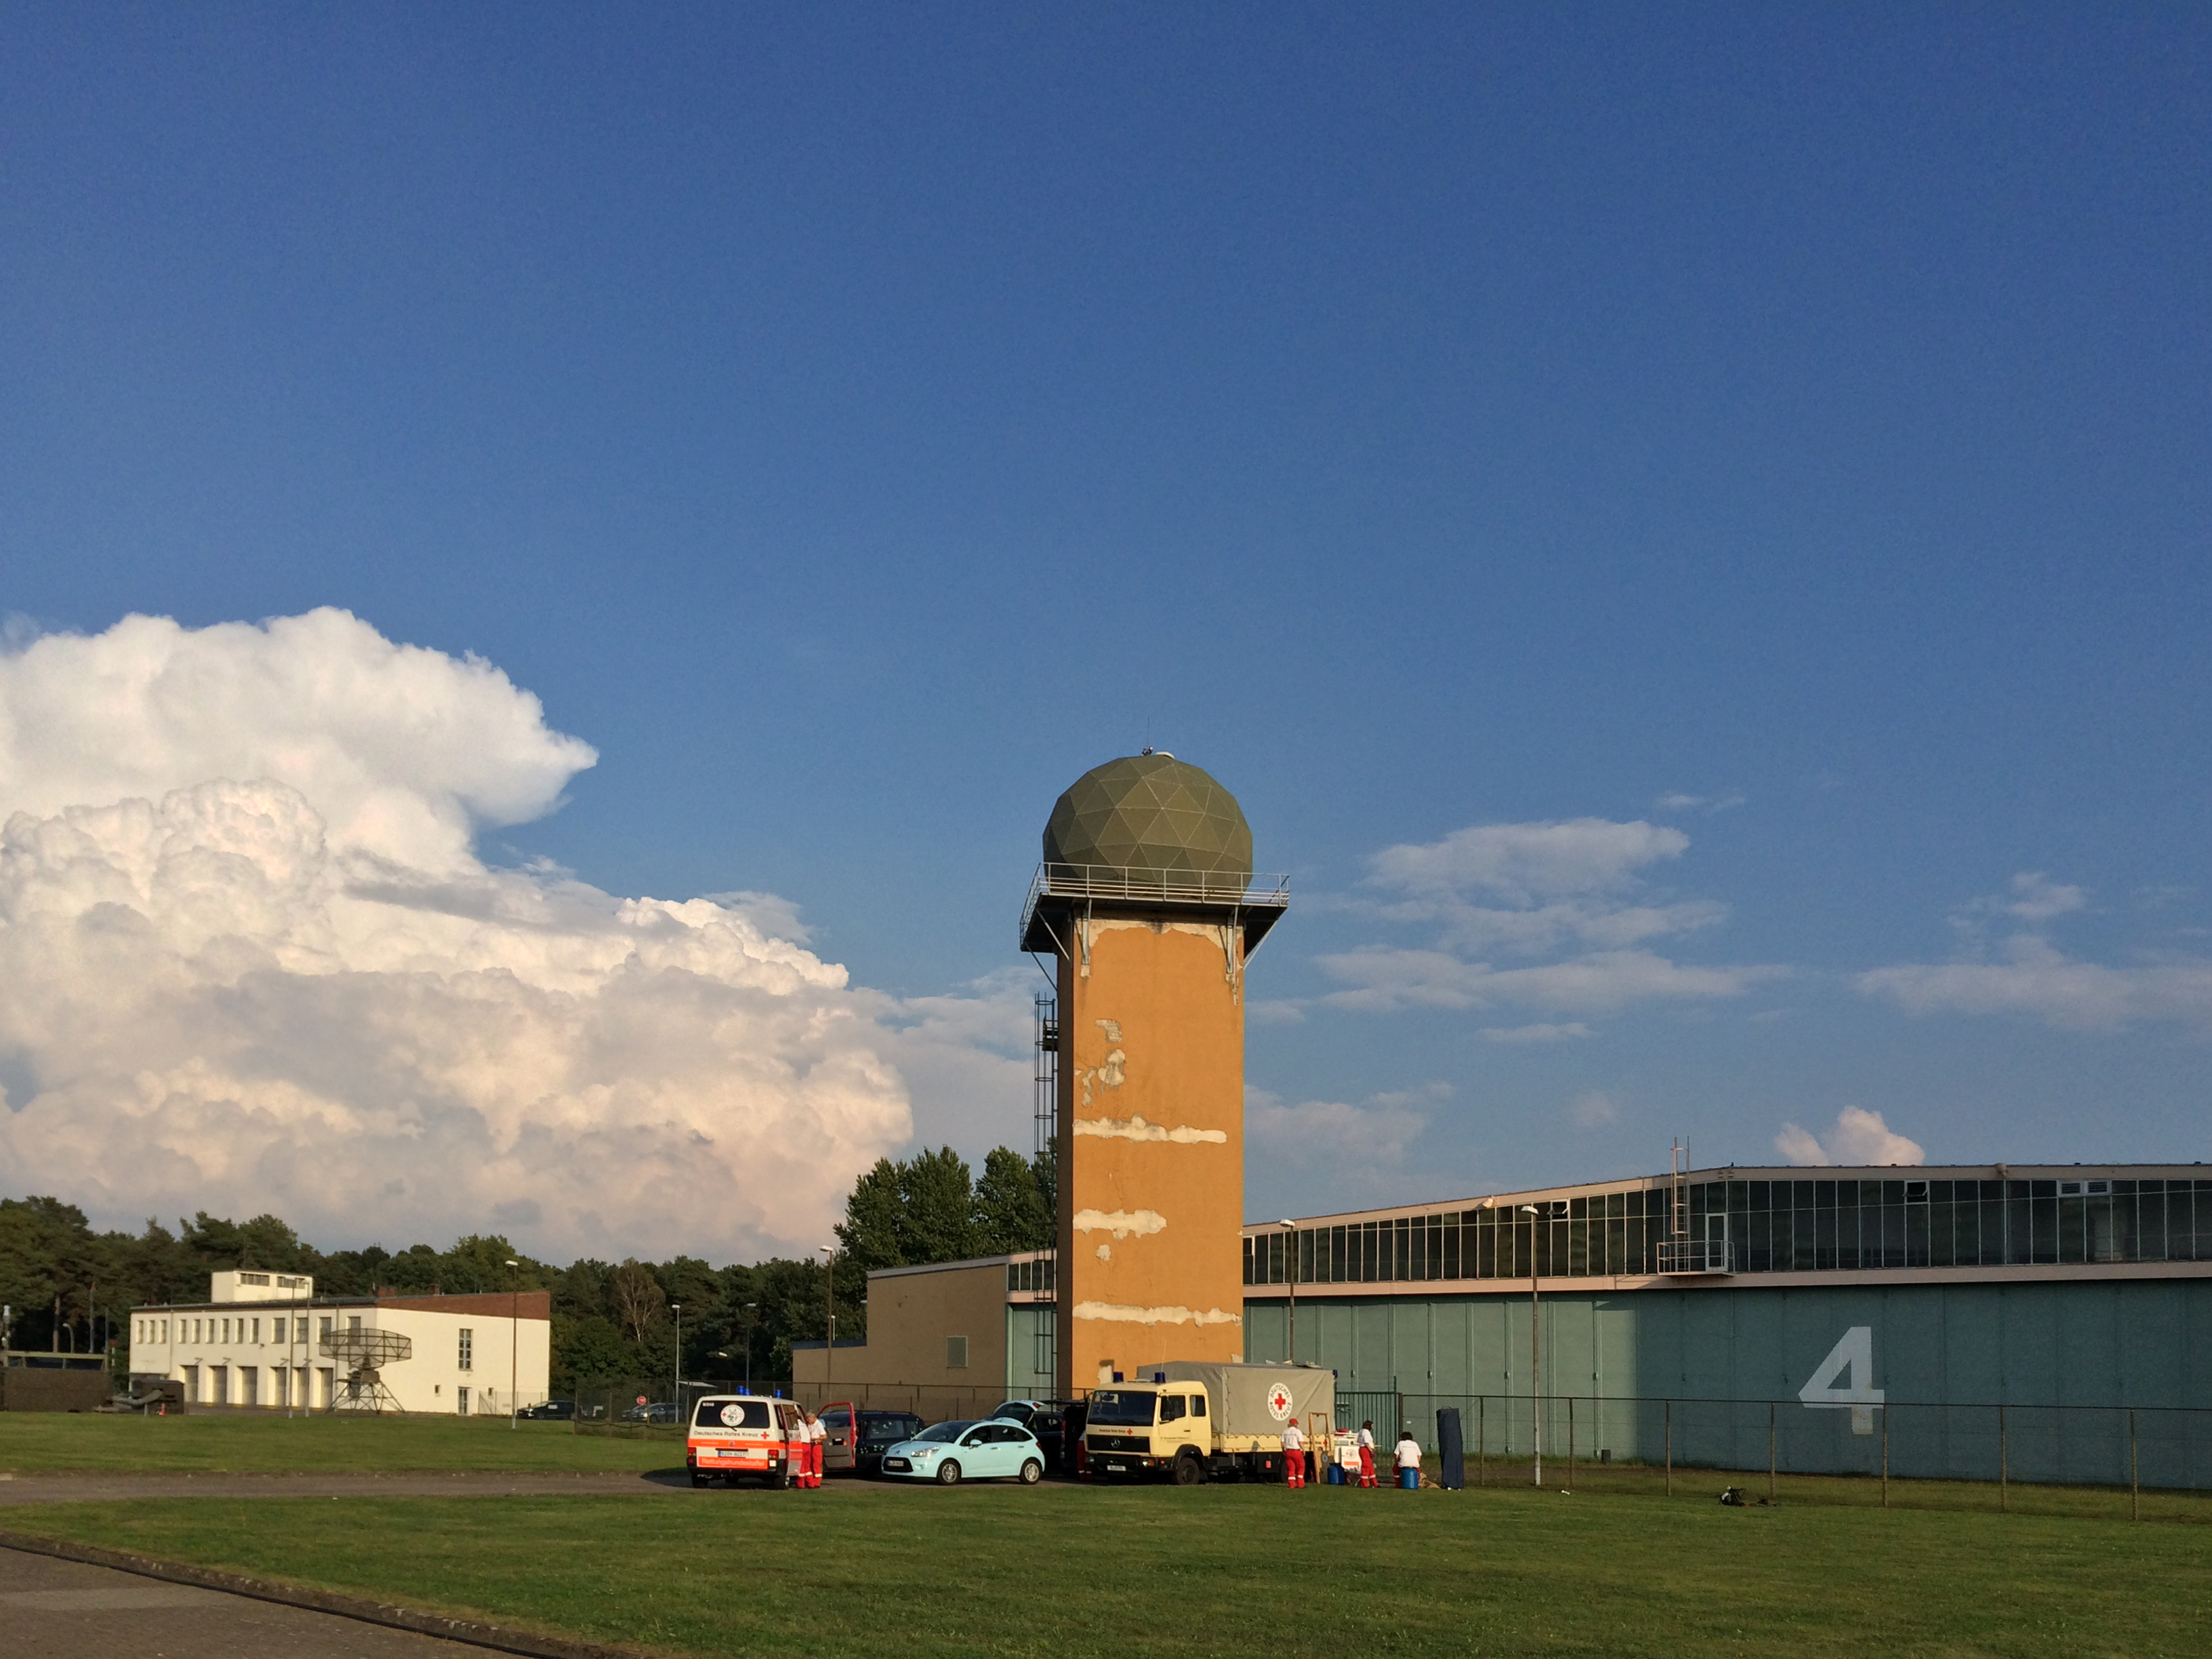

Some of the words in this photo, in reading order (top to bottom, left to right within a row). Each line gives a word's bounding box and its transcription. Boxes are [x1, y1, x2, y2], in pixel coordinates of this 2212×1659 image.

[1798, 1326, 1885, 1435] 4
[1269, 1385, 1290, 1397] DEUTSCHES
[1269, 1401, 1279, 1418] ROTES
[1280, 1402, 1291, 1418] KREUZ
[701, 1458, 765, 1467] Rettungshundestaffel
